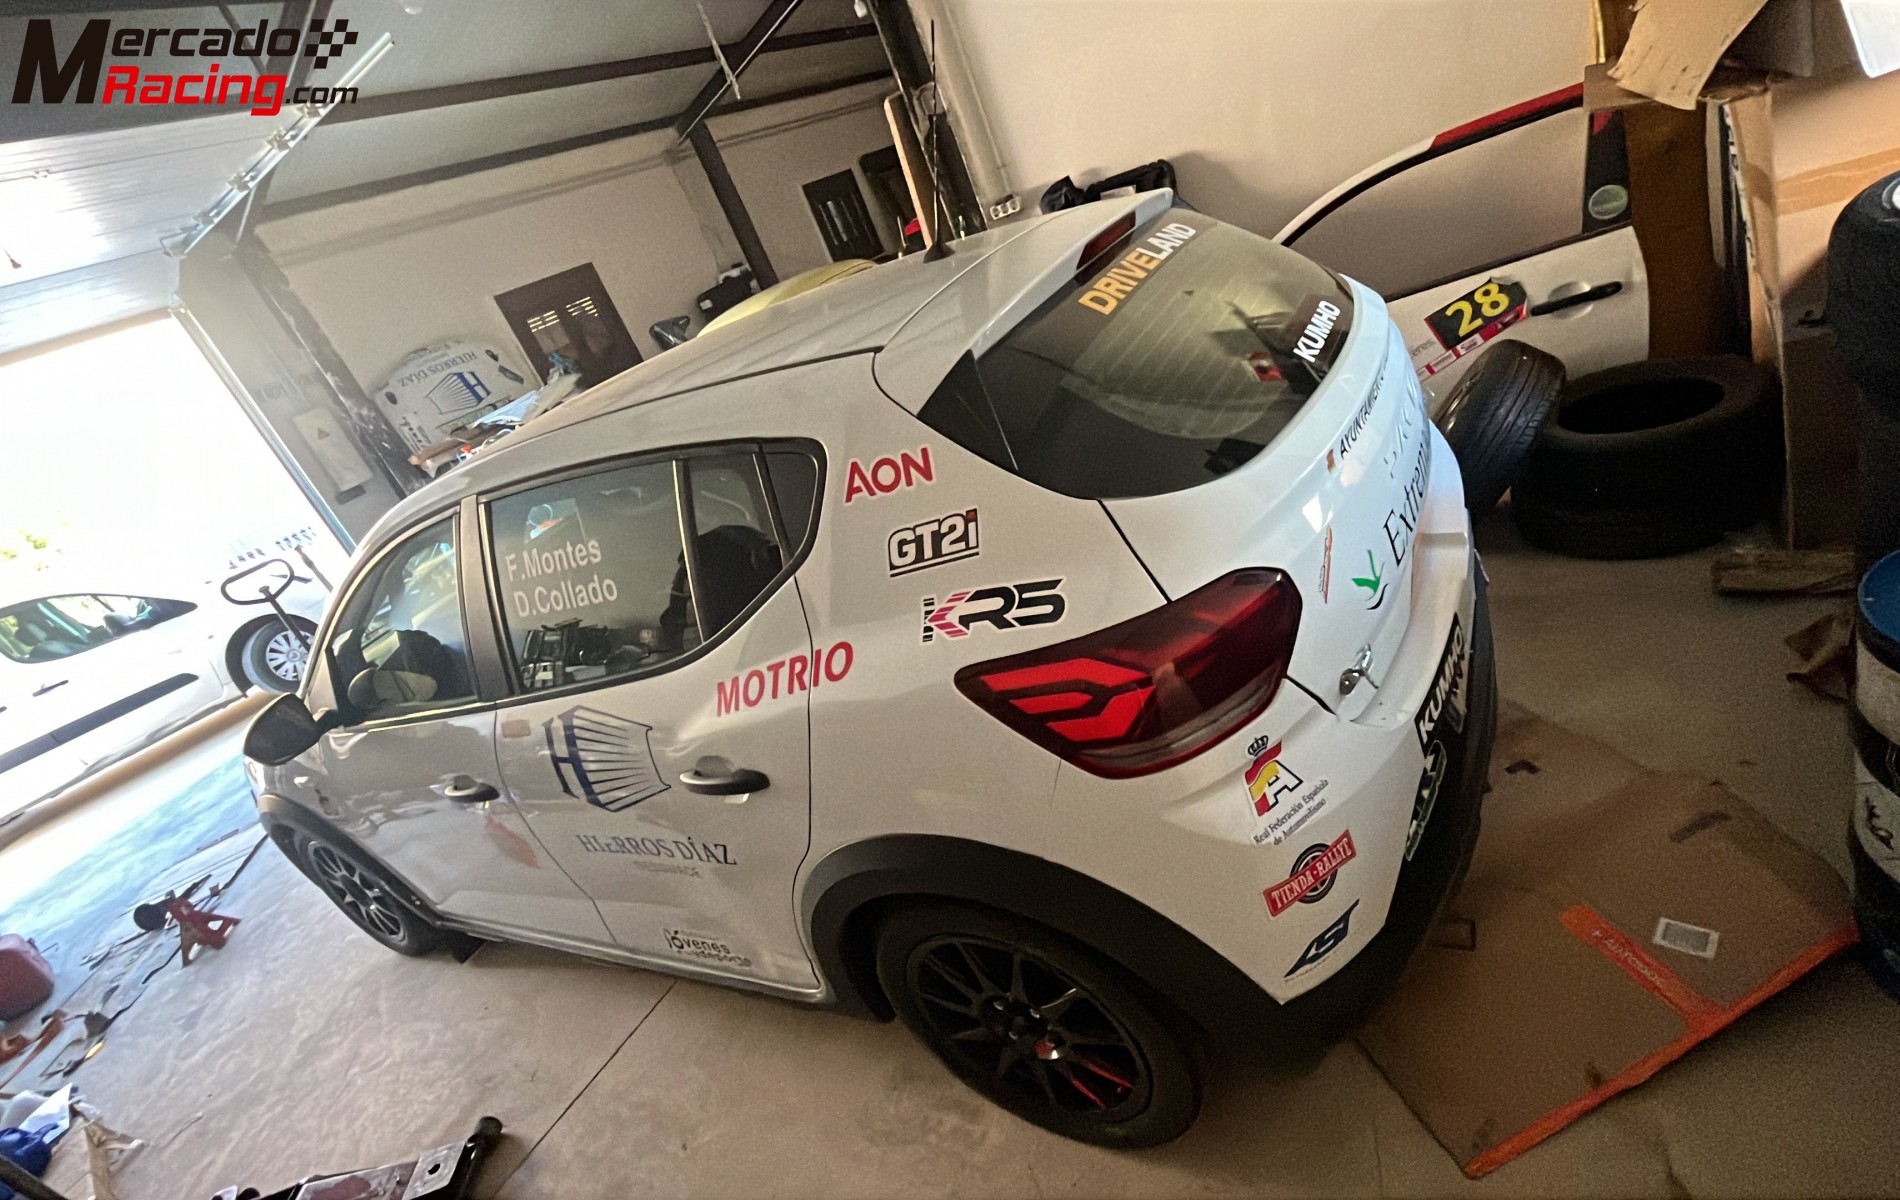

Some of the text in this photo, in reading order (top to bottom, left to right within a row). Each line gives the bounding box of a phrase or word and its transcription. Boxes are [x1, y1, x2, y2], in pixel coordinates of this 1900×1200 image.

[1078, 223, 1197, 315] DRIVELAND
[1293, 300, 1341, 363] KUMHO
[1445, 283, 1510, 337] 28
[845, 447, 933, 503] AON
[505, 540, 602, 582] F.Montes
[513, 574, 618, 618] D.Collado
[716, 641, 854, 717] MOTRIO
[1419, 624, 1463, 744] KUMHO
[673, 836, 738, 866] DÍAZ
[1253, 827, 1270, 844] Real
